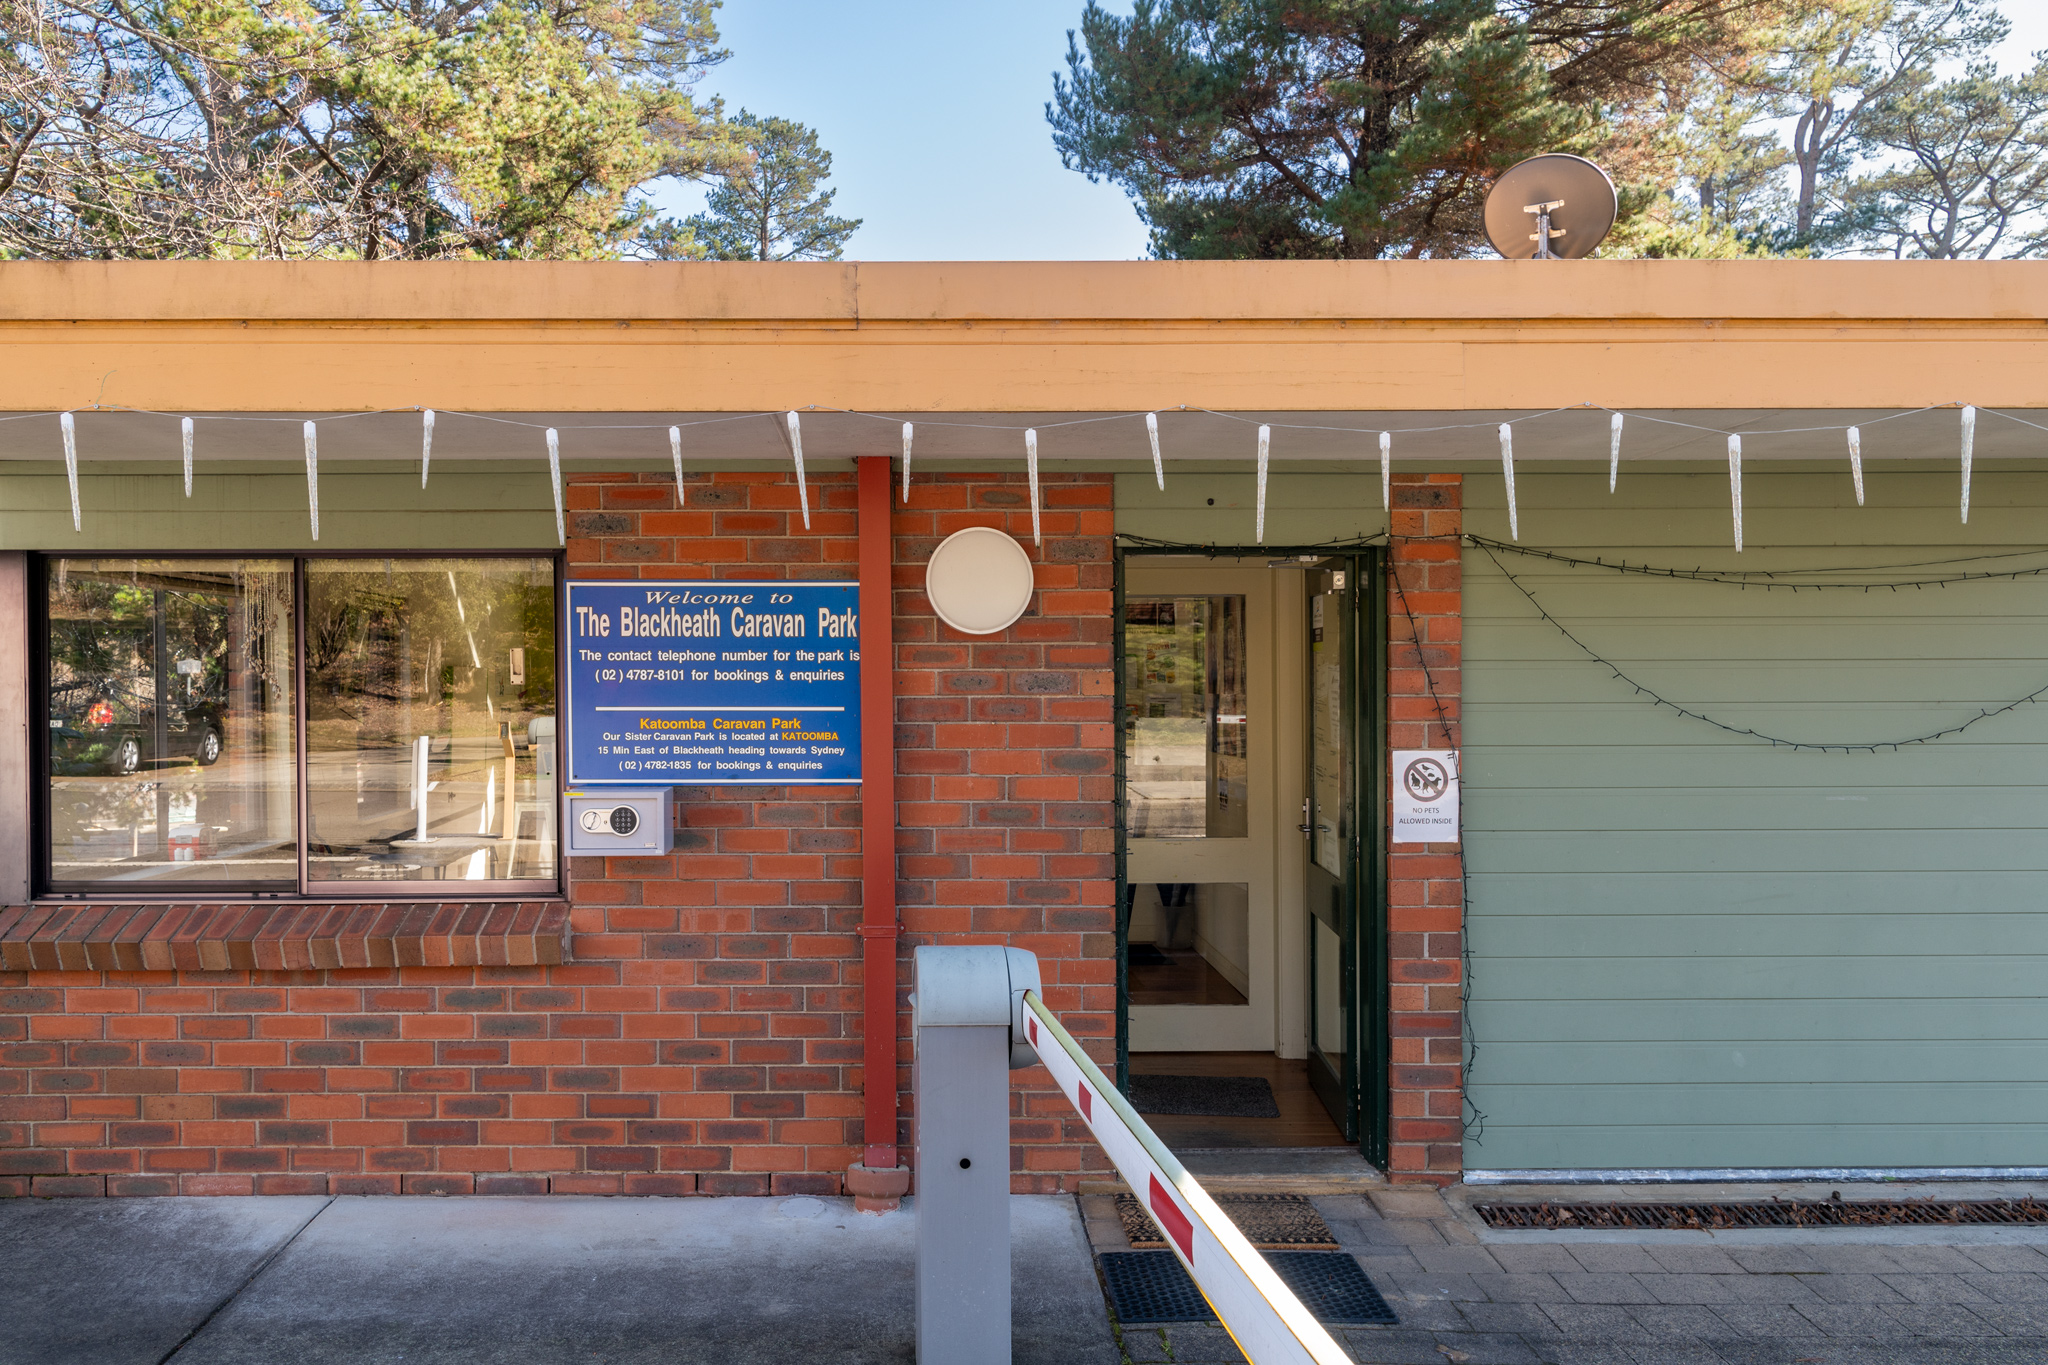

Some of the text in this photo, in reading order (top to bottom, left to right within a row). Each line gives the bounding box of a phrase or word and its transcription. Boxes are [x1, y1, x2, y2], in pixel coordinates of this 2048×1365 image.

[646, 591, 792, 604] Welcome to
[576, 607, 857, 638] The Blackheath Caravan Park
[579, 650, 860, 664] The contact telephone number for the park is
[691, 670, 708, 681] for
[715, 670, 768, 684] bookings
[775, 670, 783, 681] &
[790, 670, 844, 684] enquiries
[640, 718, 801, 730] Katoomba Caravan Park
[603, 732, 838, 742] Our Sister Caravan Park is located at KATOOMBA
[598, 746, 844, 757] 15 Min East of Blackheath heading towards Sydney
[698, 761, 711, 770] for
[717, 761, 761, 772] bookings
[766, 761, 773, 770] &
[778, 761, 822, 772] enquiries
